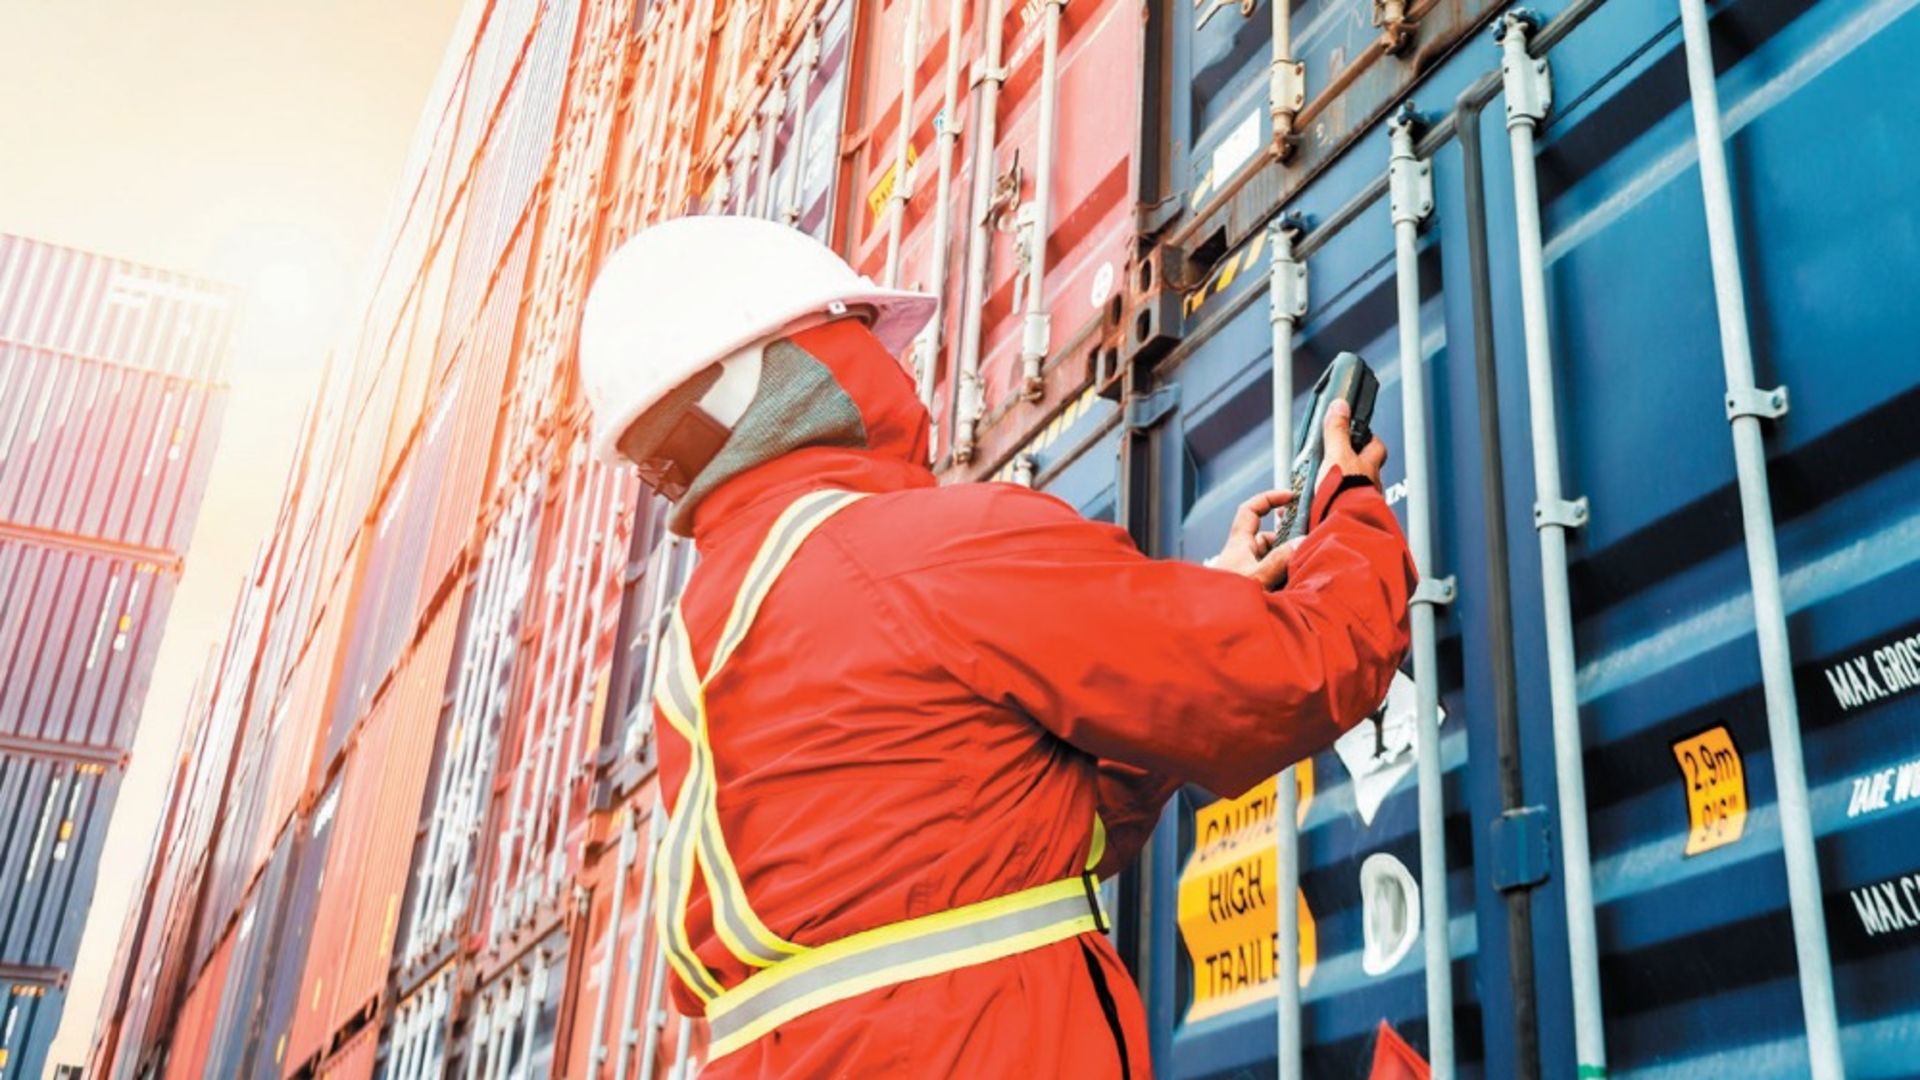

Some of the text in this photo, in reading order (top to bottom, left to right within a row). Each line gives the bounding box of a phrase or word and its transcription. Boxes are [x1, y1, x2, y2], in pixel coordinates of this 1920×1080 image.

[1684, 744, 1737, 791] 2.9m
[1847, 768, 1896, 818] TARE
[1208, 857, 1266, 924] HIGH
